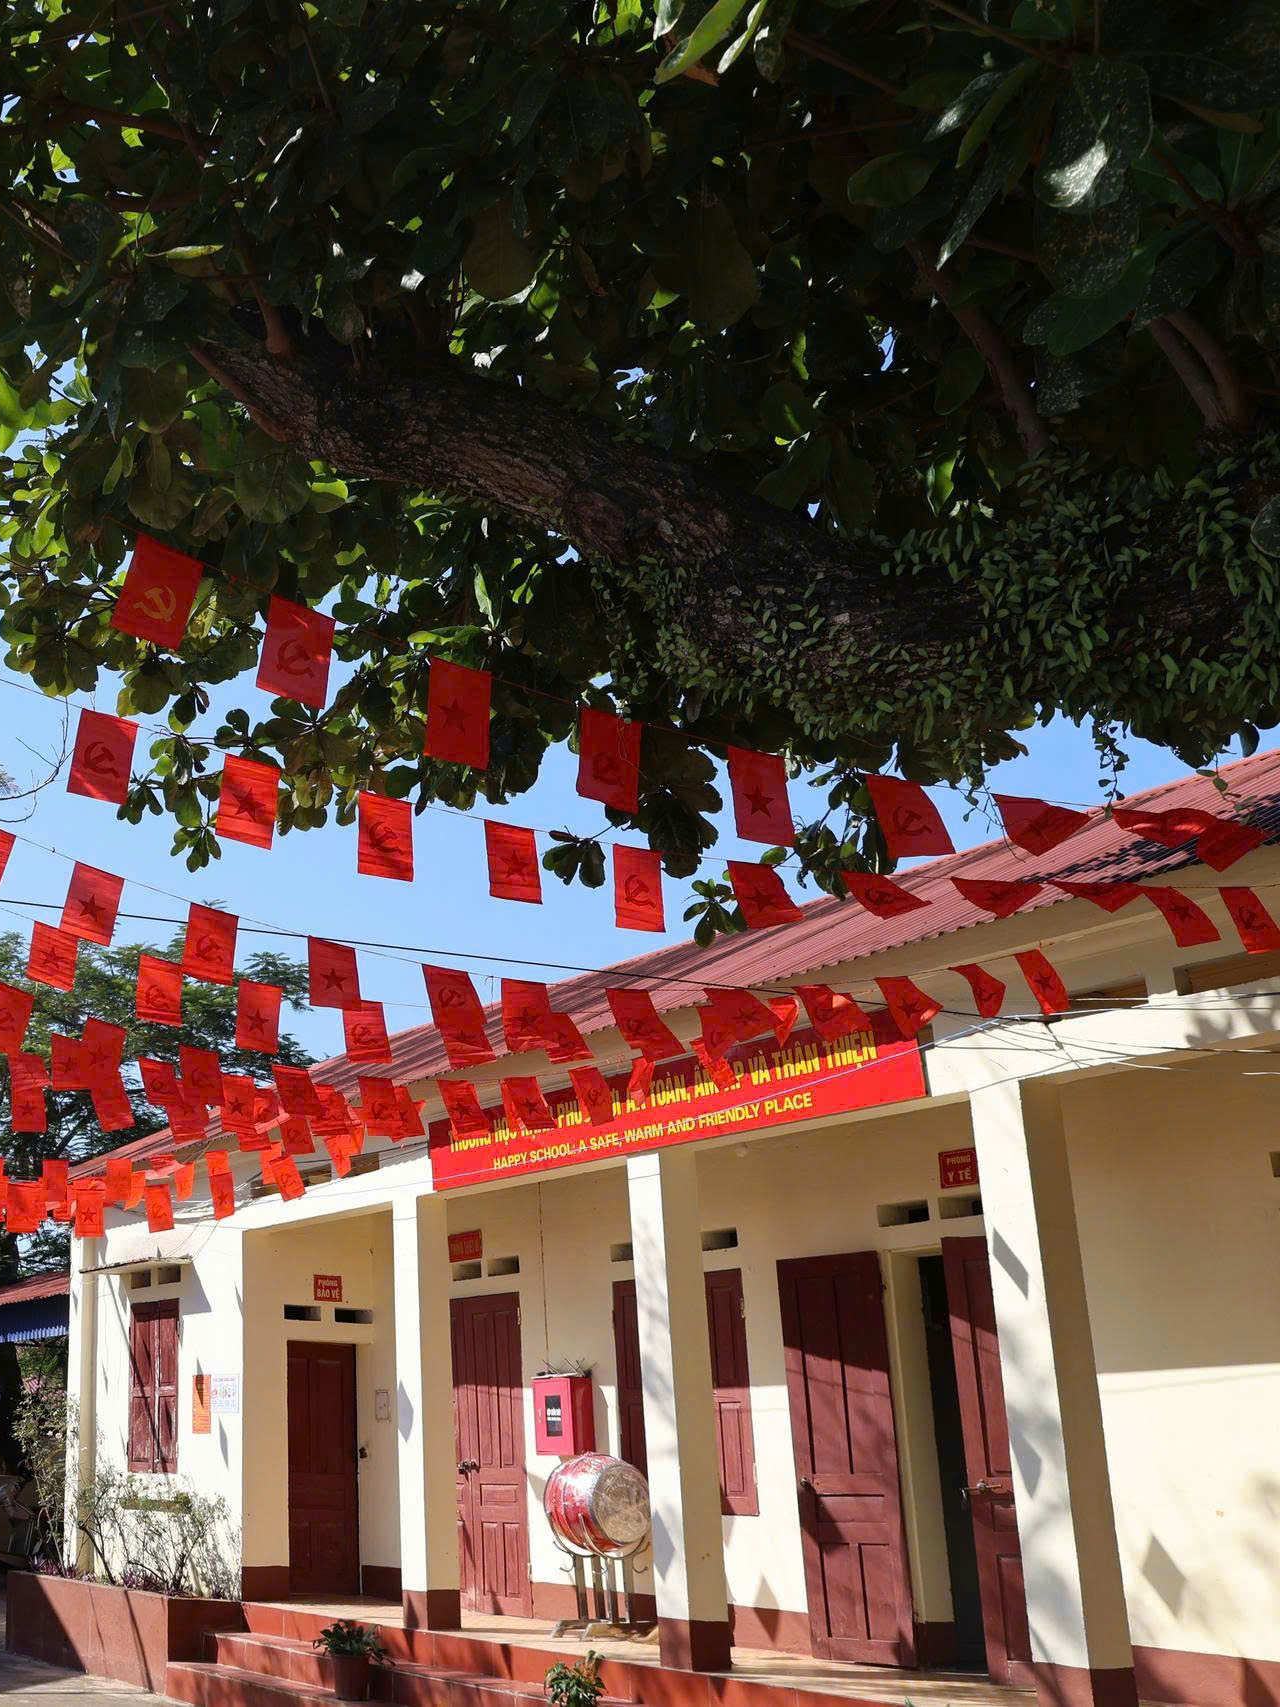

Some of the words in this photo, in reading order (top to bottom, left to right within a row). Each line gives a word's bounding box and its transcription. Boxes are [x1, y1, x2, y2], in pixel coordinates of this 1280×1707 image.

[748, 1050, 771, 1086] VÀ
[772, 1041, 821, 1080] THÂN
[822, 1029, 878, 1069] THIỆN
[493, 1152, 528, 1171] HAPPY
[578, 1139, 587, 1153] A
[589, 1132, 623, 1151] SAFE,
[624, 1122, 664, 1143] WARM
[667, 1116, 696, 1136] AND
[699, 1101, 761, 1129] FRIENDLY
[764, 1092, 813, 1116] PLACE
[947, 1171, 955, 1182] Y
